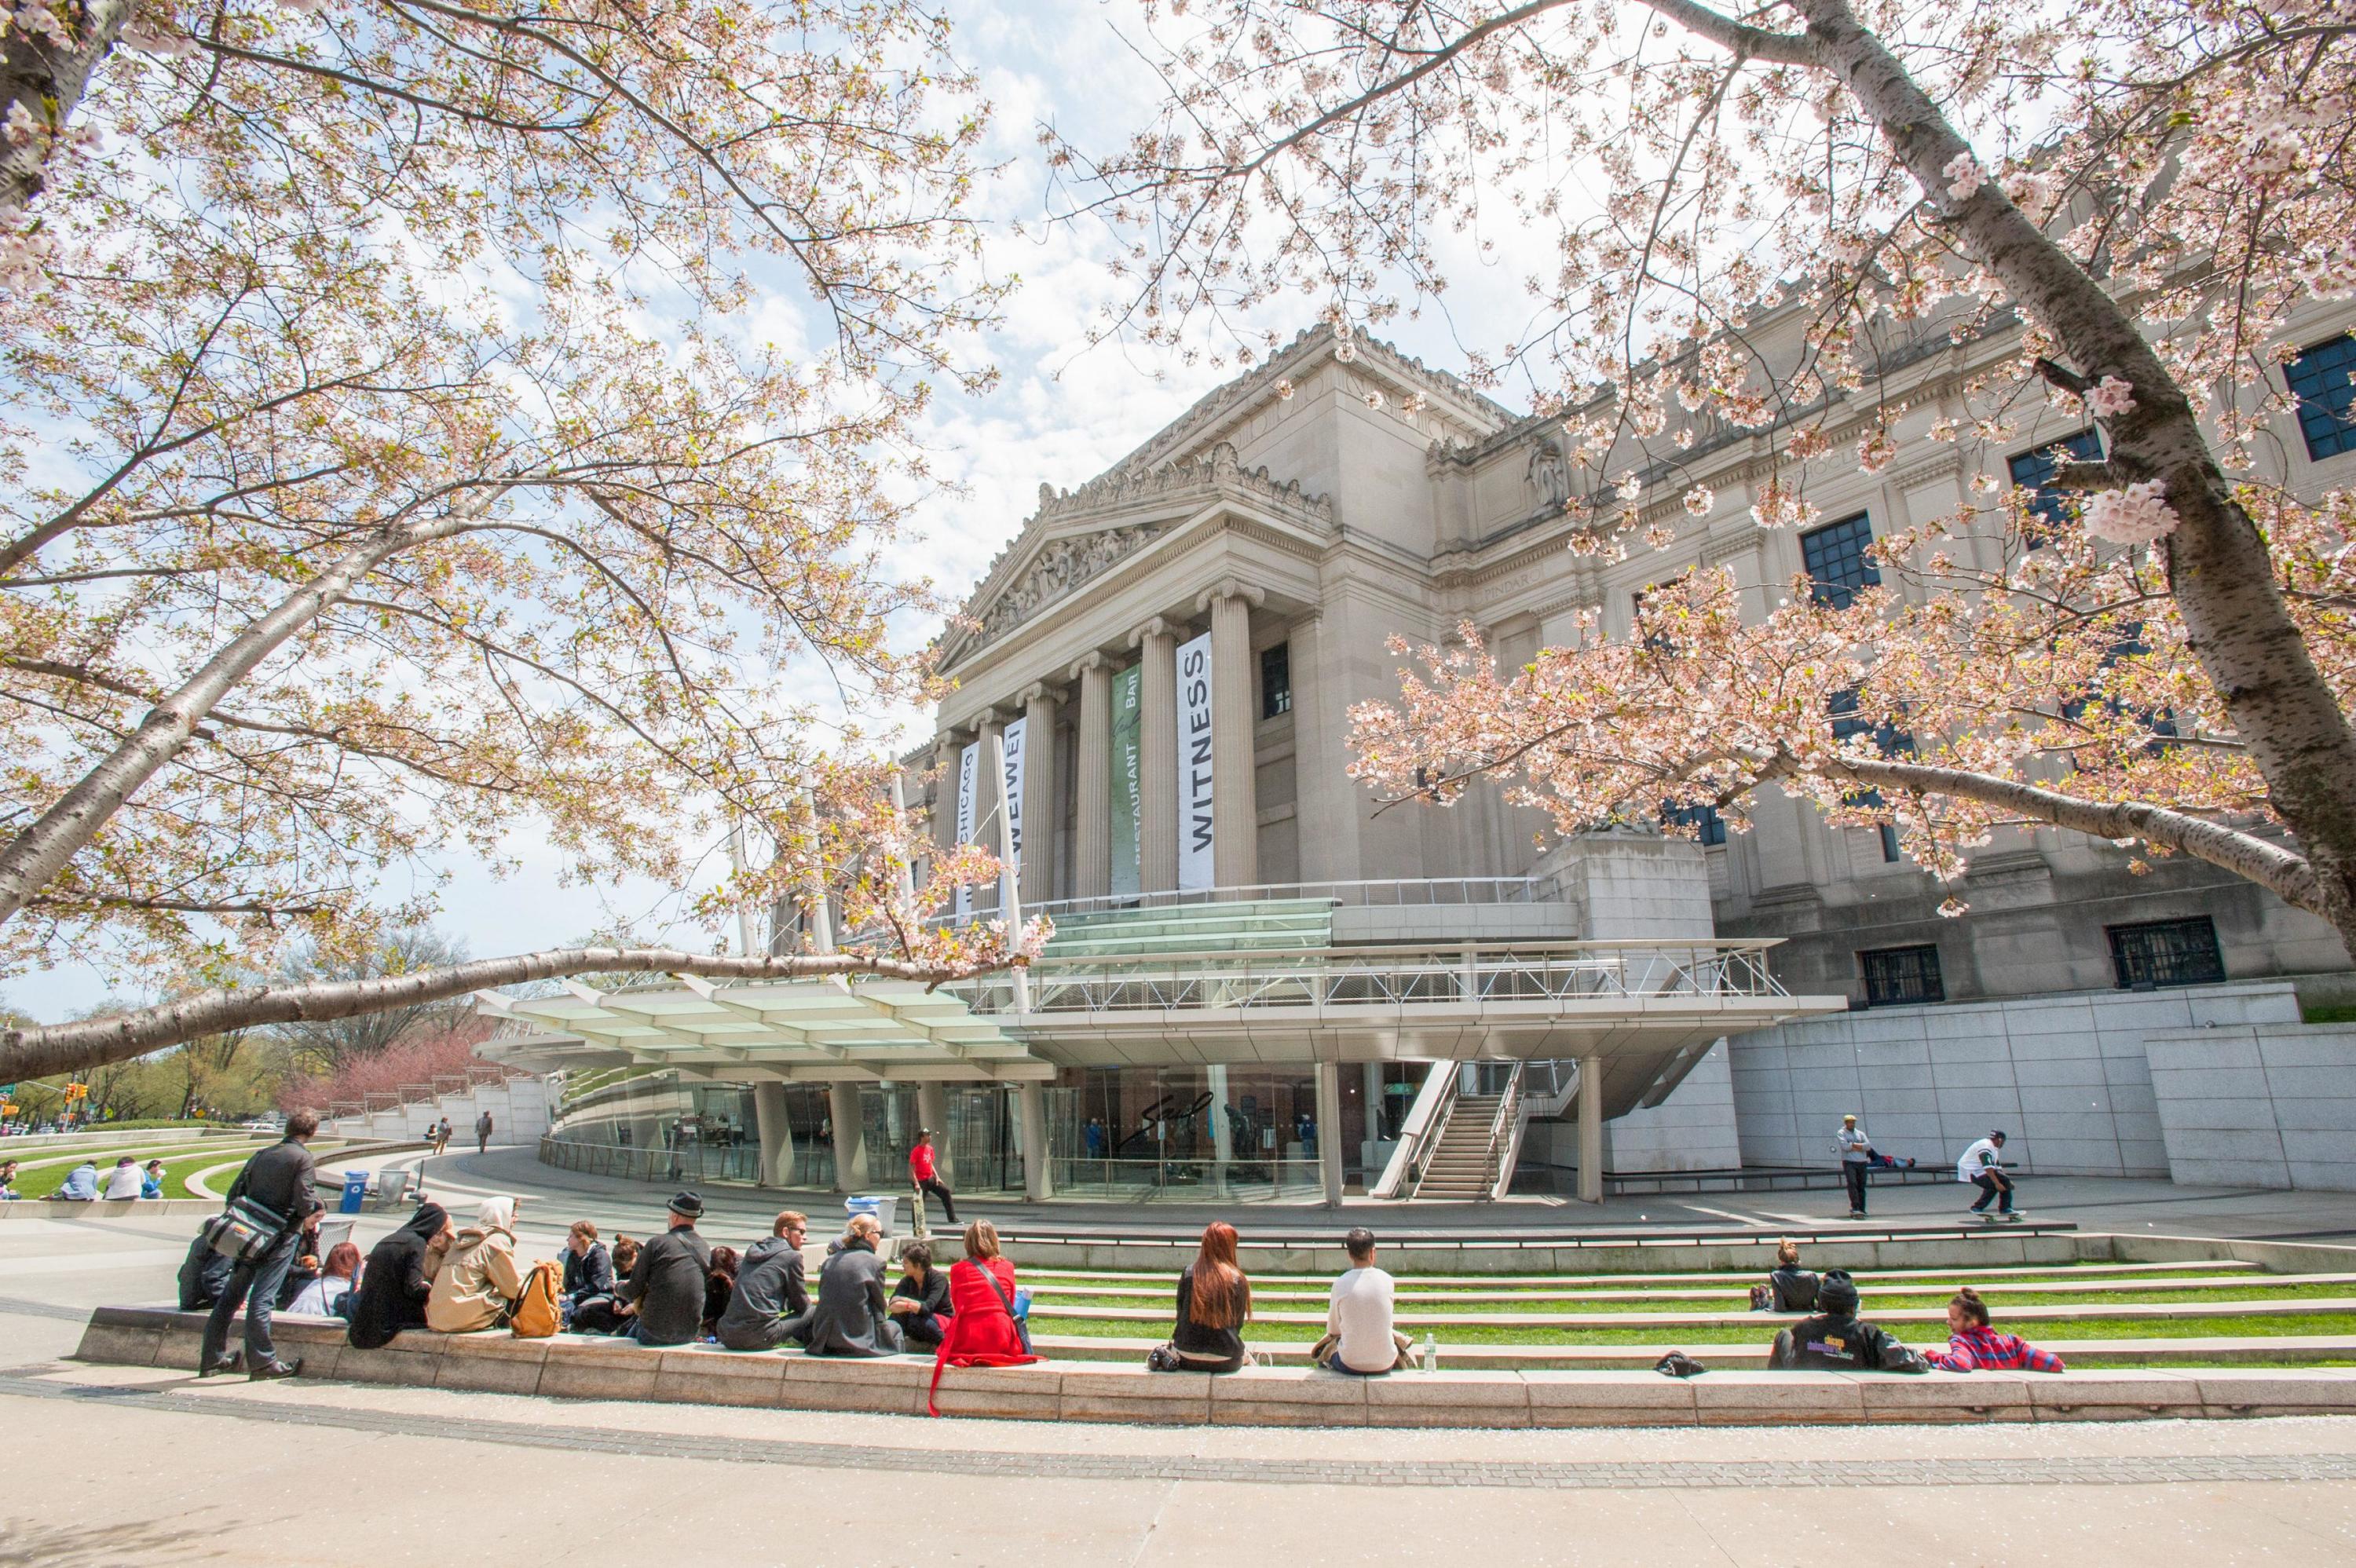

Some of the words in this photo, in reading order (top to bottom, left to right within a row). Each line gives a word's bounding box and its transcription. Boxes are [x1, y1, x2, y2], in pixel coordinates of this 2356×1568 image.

[1125, 673, 1138, 709] BAR
[1184, 649, 1213, 853] WITNESS
[960, 752, 974, 846] CHICAGO
